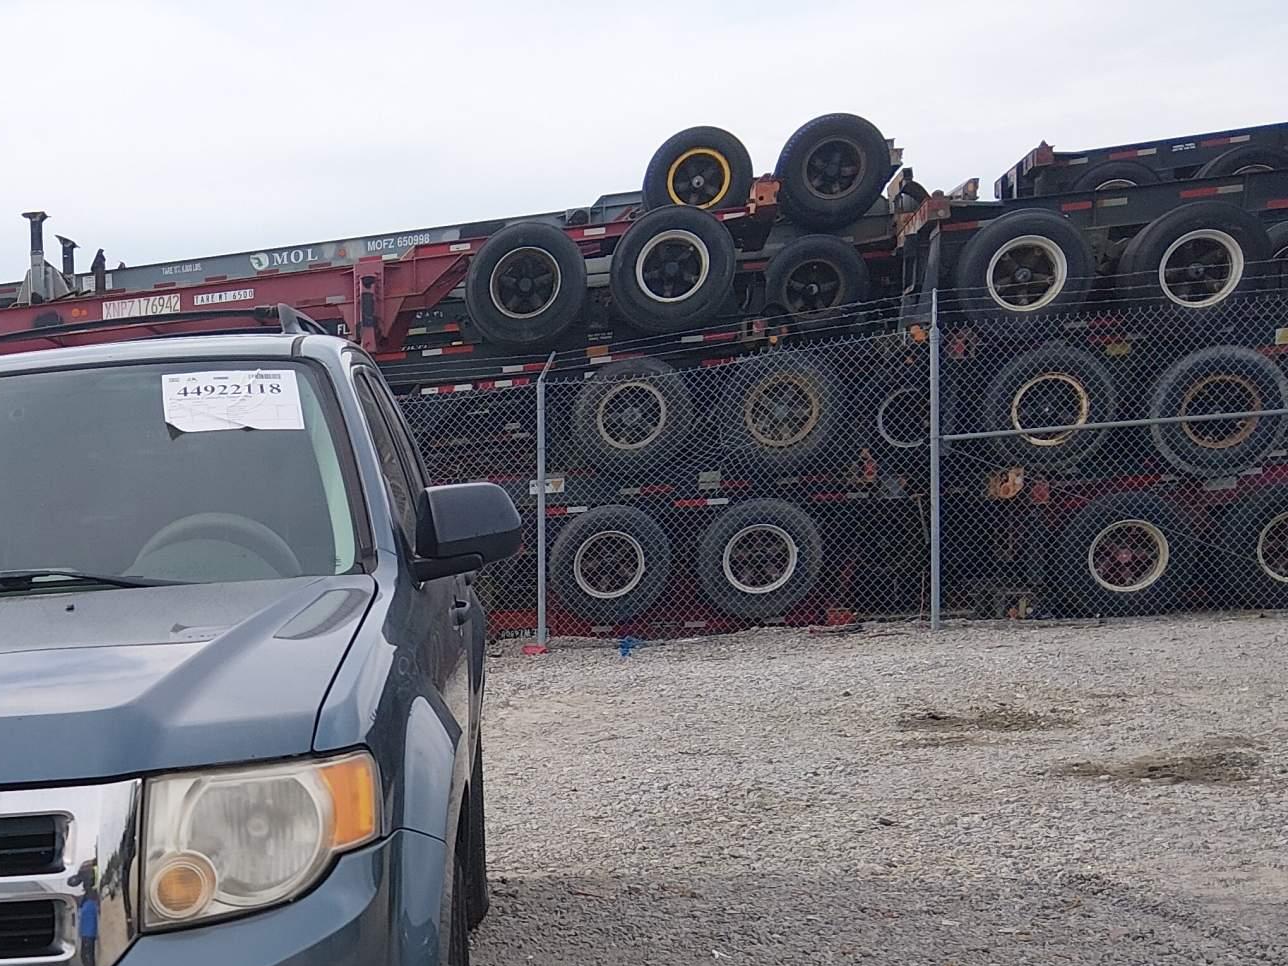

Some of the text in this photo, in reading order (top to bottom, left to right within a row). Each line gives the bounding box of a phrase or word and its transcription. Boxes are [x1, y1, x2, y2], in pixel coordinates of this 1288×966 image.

[367, 233, 430, 252] MOFZ 650998
[273, 248, 319, 266] MOL
[194, 290, 253, 305] TARE WT 6500
[177, 383, 282, 397] 44922118
